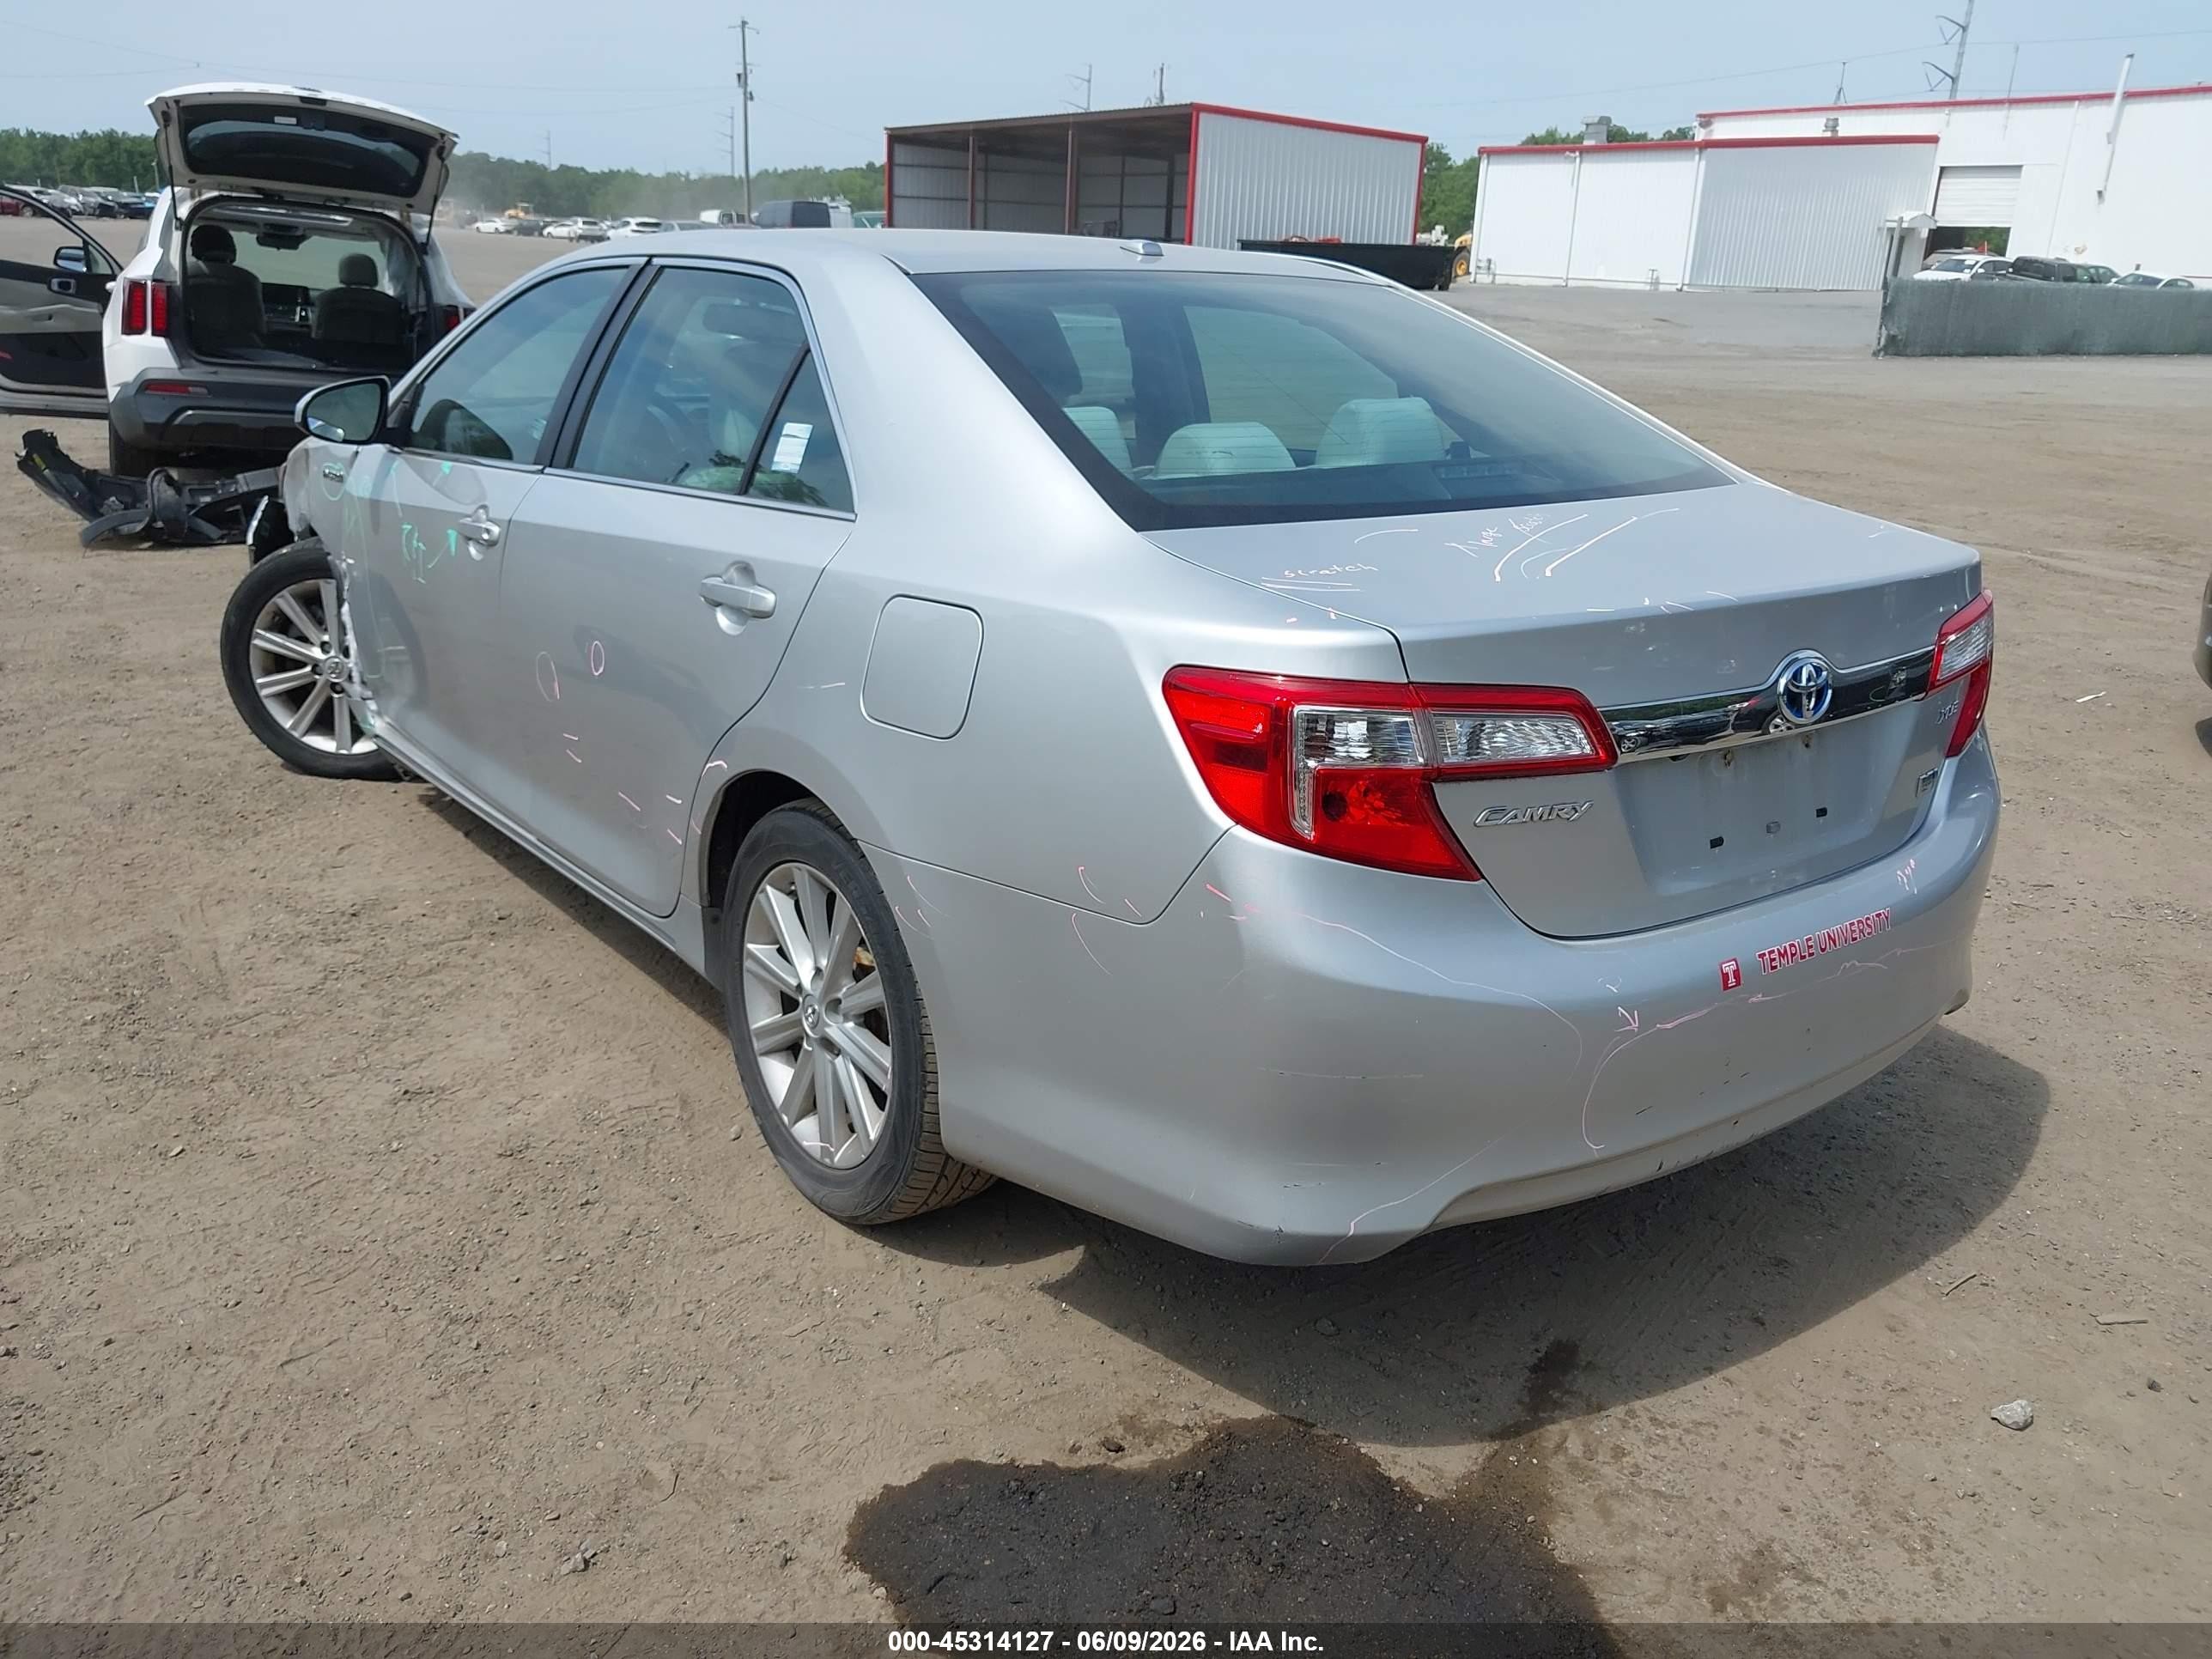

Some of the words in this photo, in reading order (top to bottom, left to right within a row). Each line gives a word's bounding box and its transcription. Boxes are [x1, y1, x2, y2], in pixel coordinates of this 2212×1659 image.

[1474, 799, 1594, 827] CAMRY
[1756, 934, 1815, 975] TEMPLE
[1815, 907, 1891, 955] UNIVERSITY
